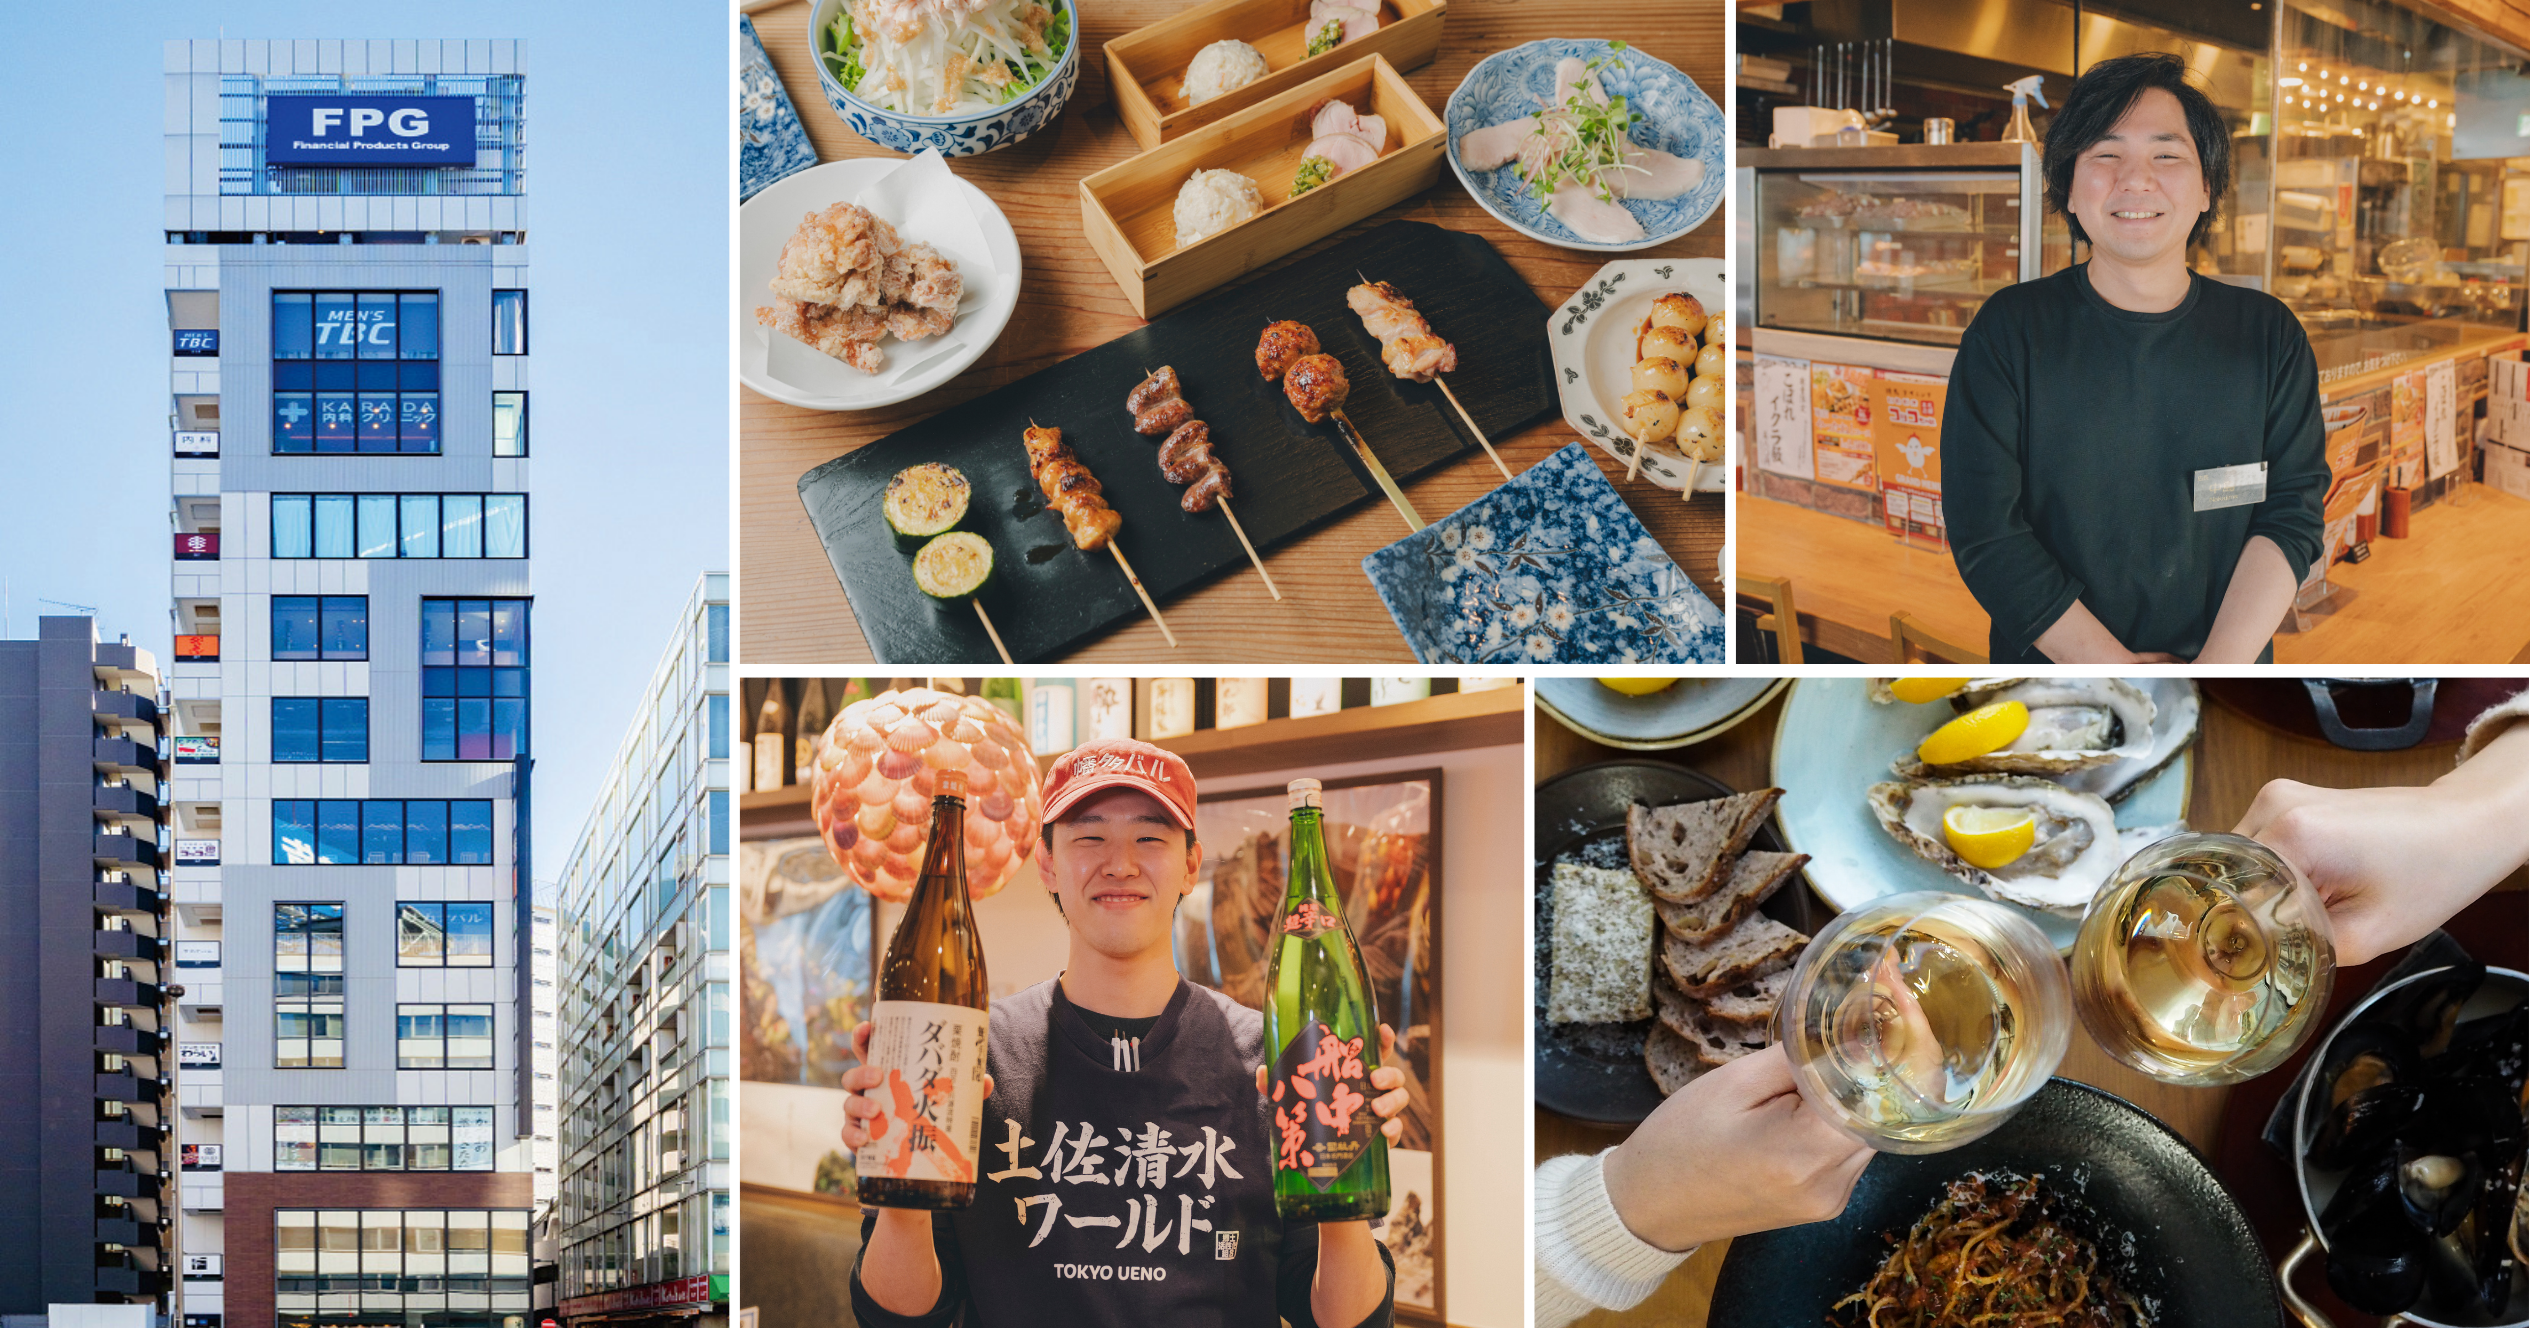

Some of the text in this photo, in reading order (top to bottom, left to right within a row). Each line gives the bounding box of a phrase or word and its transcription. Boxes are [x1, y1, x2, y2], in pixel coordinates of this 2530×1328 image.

[312, 108, 429, 137] FPG
[293, 141, 450, 151] Financial Products Group
[327, 310, 386, 321] MEN'S
[179, 337, 213, 349] TBC
[315, 322, 396, 345] TBC
[322, 402, 434, 413] KARADA
[322, 413, 436, 422] 内科クリニック
[1073, 752, 1171, 783] 幡多バル
[1283, 911, 1337, 932] 超辛口
[910, 1019, 948, 1153] ダバダ火振
[987, 1118, 1244, 1190] 土佐清水
[1013, 1193, 1216, 1256] ワールド
[1054, 1263, 1167, 1281] TOKYO UENO
